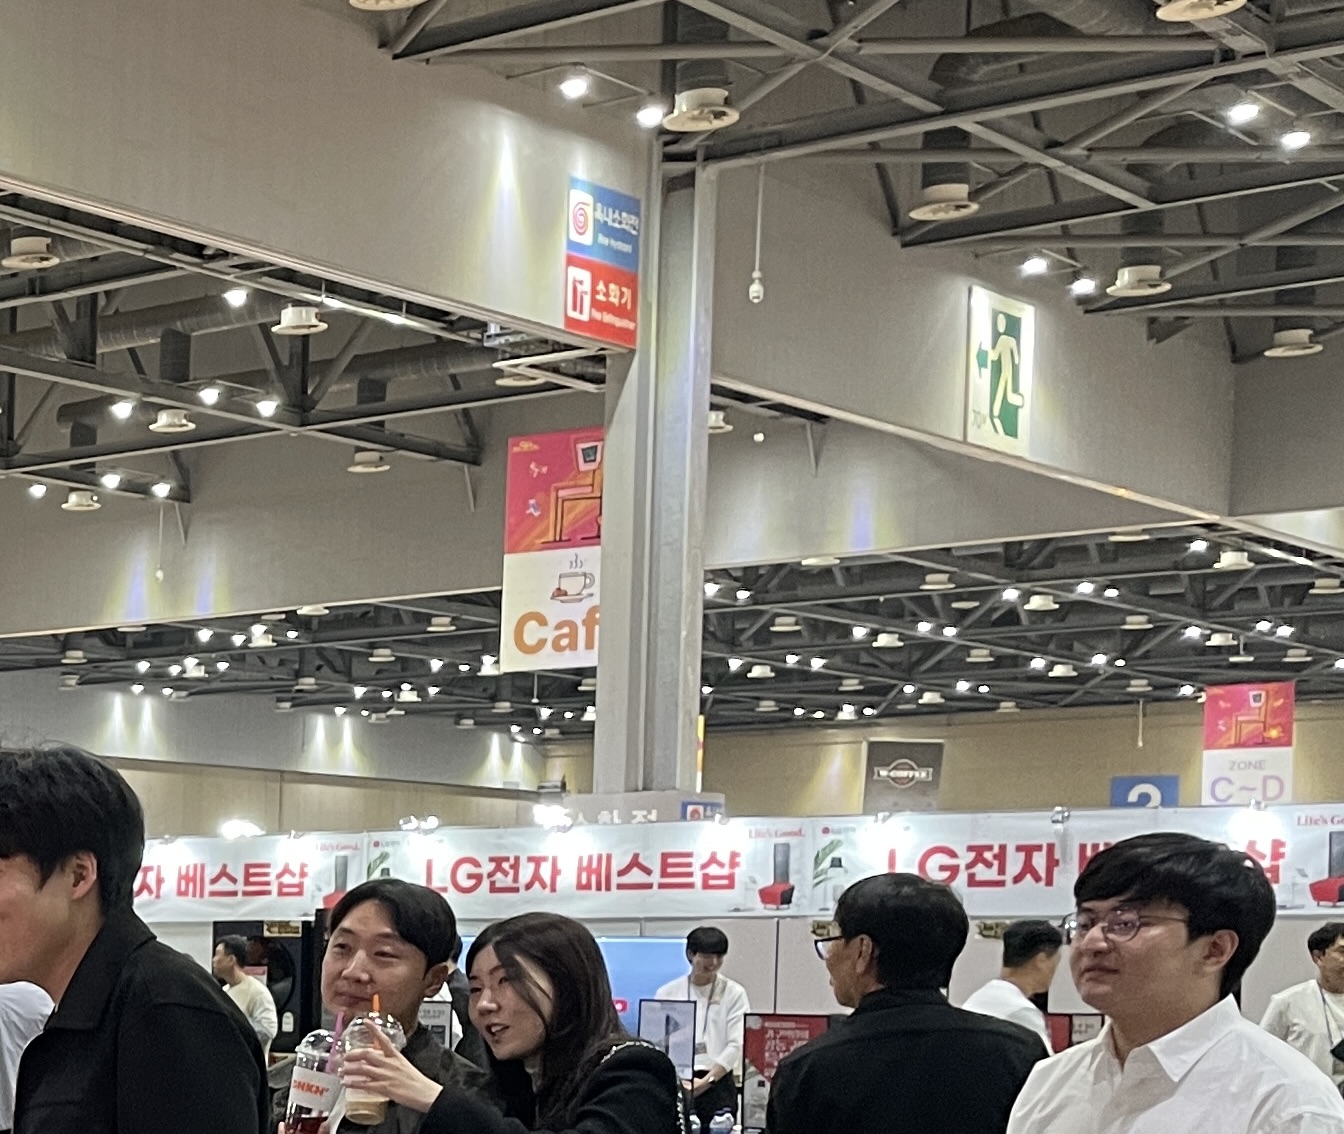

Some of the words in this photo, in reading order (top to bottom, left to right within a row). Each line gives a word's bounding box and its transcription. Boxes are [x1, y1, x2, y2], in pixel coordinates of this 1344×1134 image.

[595, 280, 632, 311] 소화기
[1228, 759, 1267, 772] ZONE
[1325, 813, 1344, 828] Go
[176, 861, 308, 899] 베스트샵
[424, 853, 562, 895] LG전자
[576, 849, 742, 893] 베스트샵
